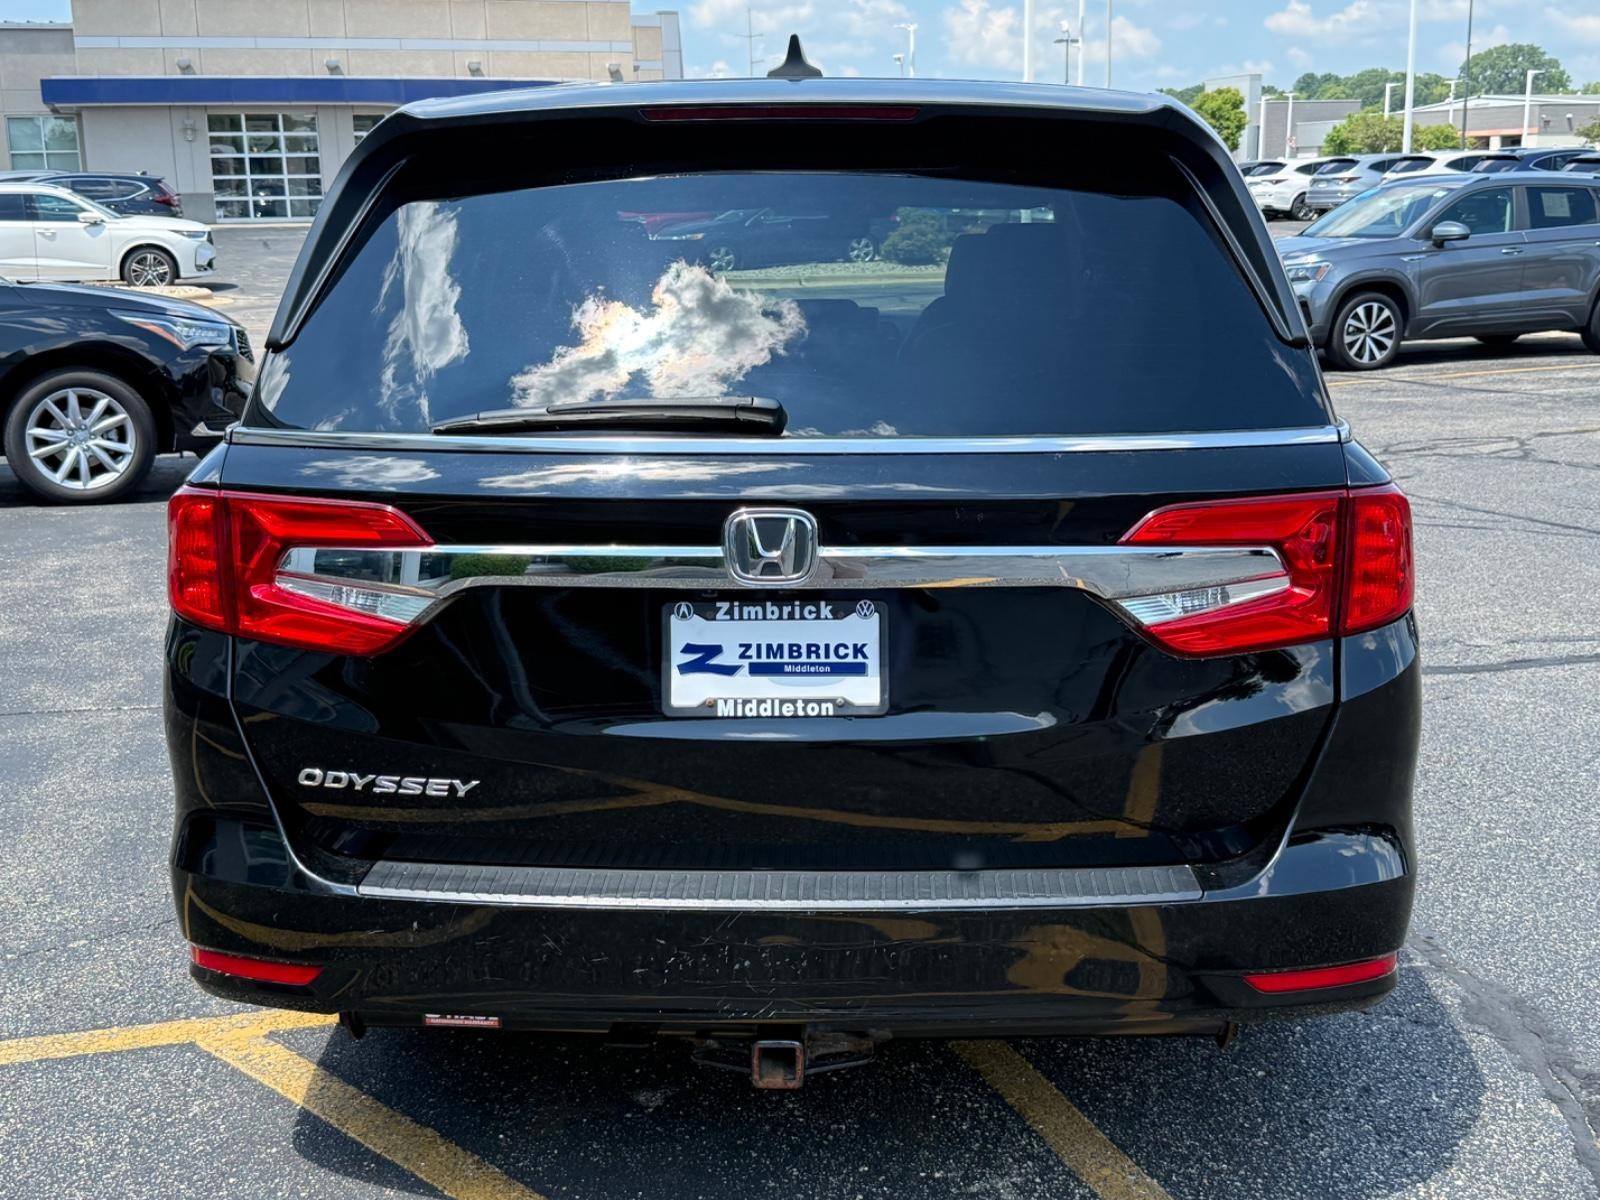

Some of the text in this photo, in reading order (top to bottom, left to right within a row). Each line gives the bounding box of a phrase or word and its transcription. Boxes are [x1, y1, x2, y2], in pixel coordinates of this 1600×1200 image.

[715, 601, 833, 620] Zimbrick
[738, 643, 869, 660] ZIMBRICK
[784, 664, 831, 673] Middleton
[716, 700, 834, 717] Middleton
[298, 768, 480, 797] ODYSSEY
